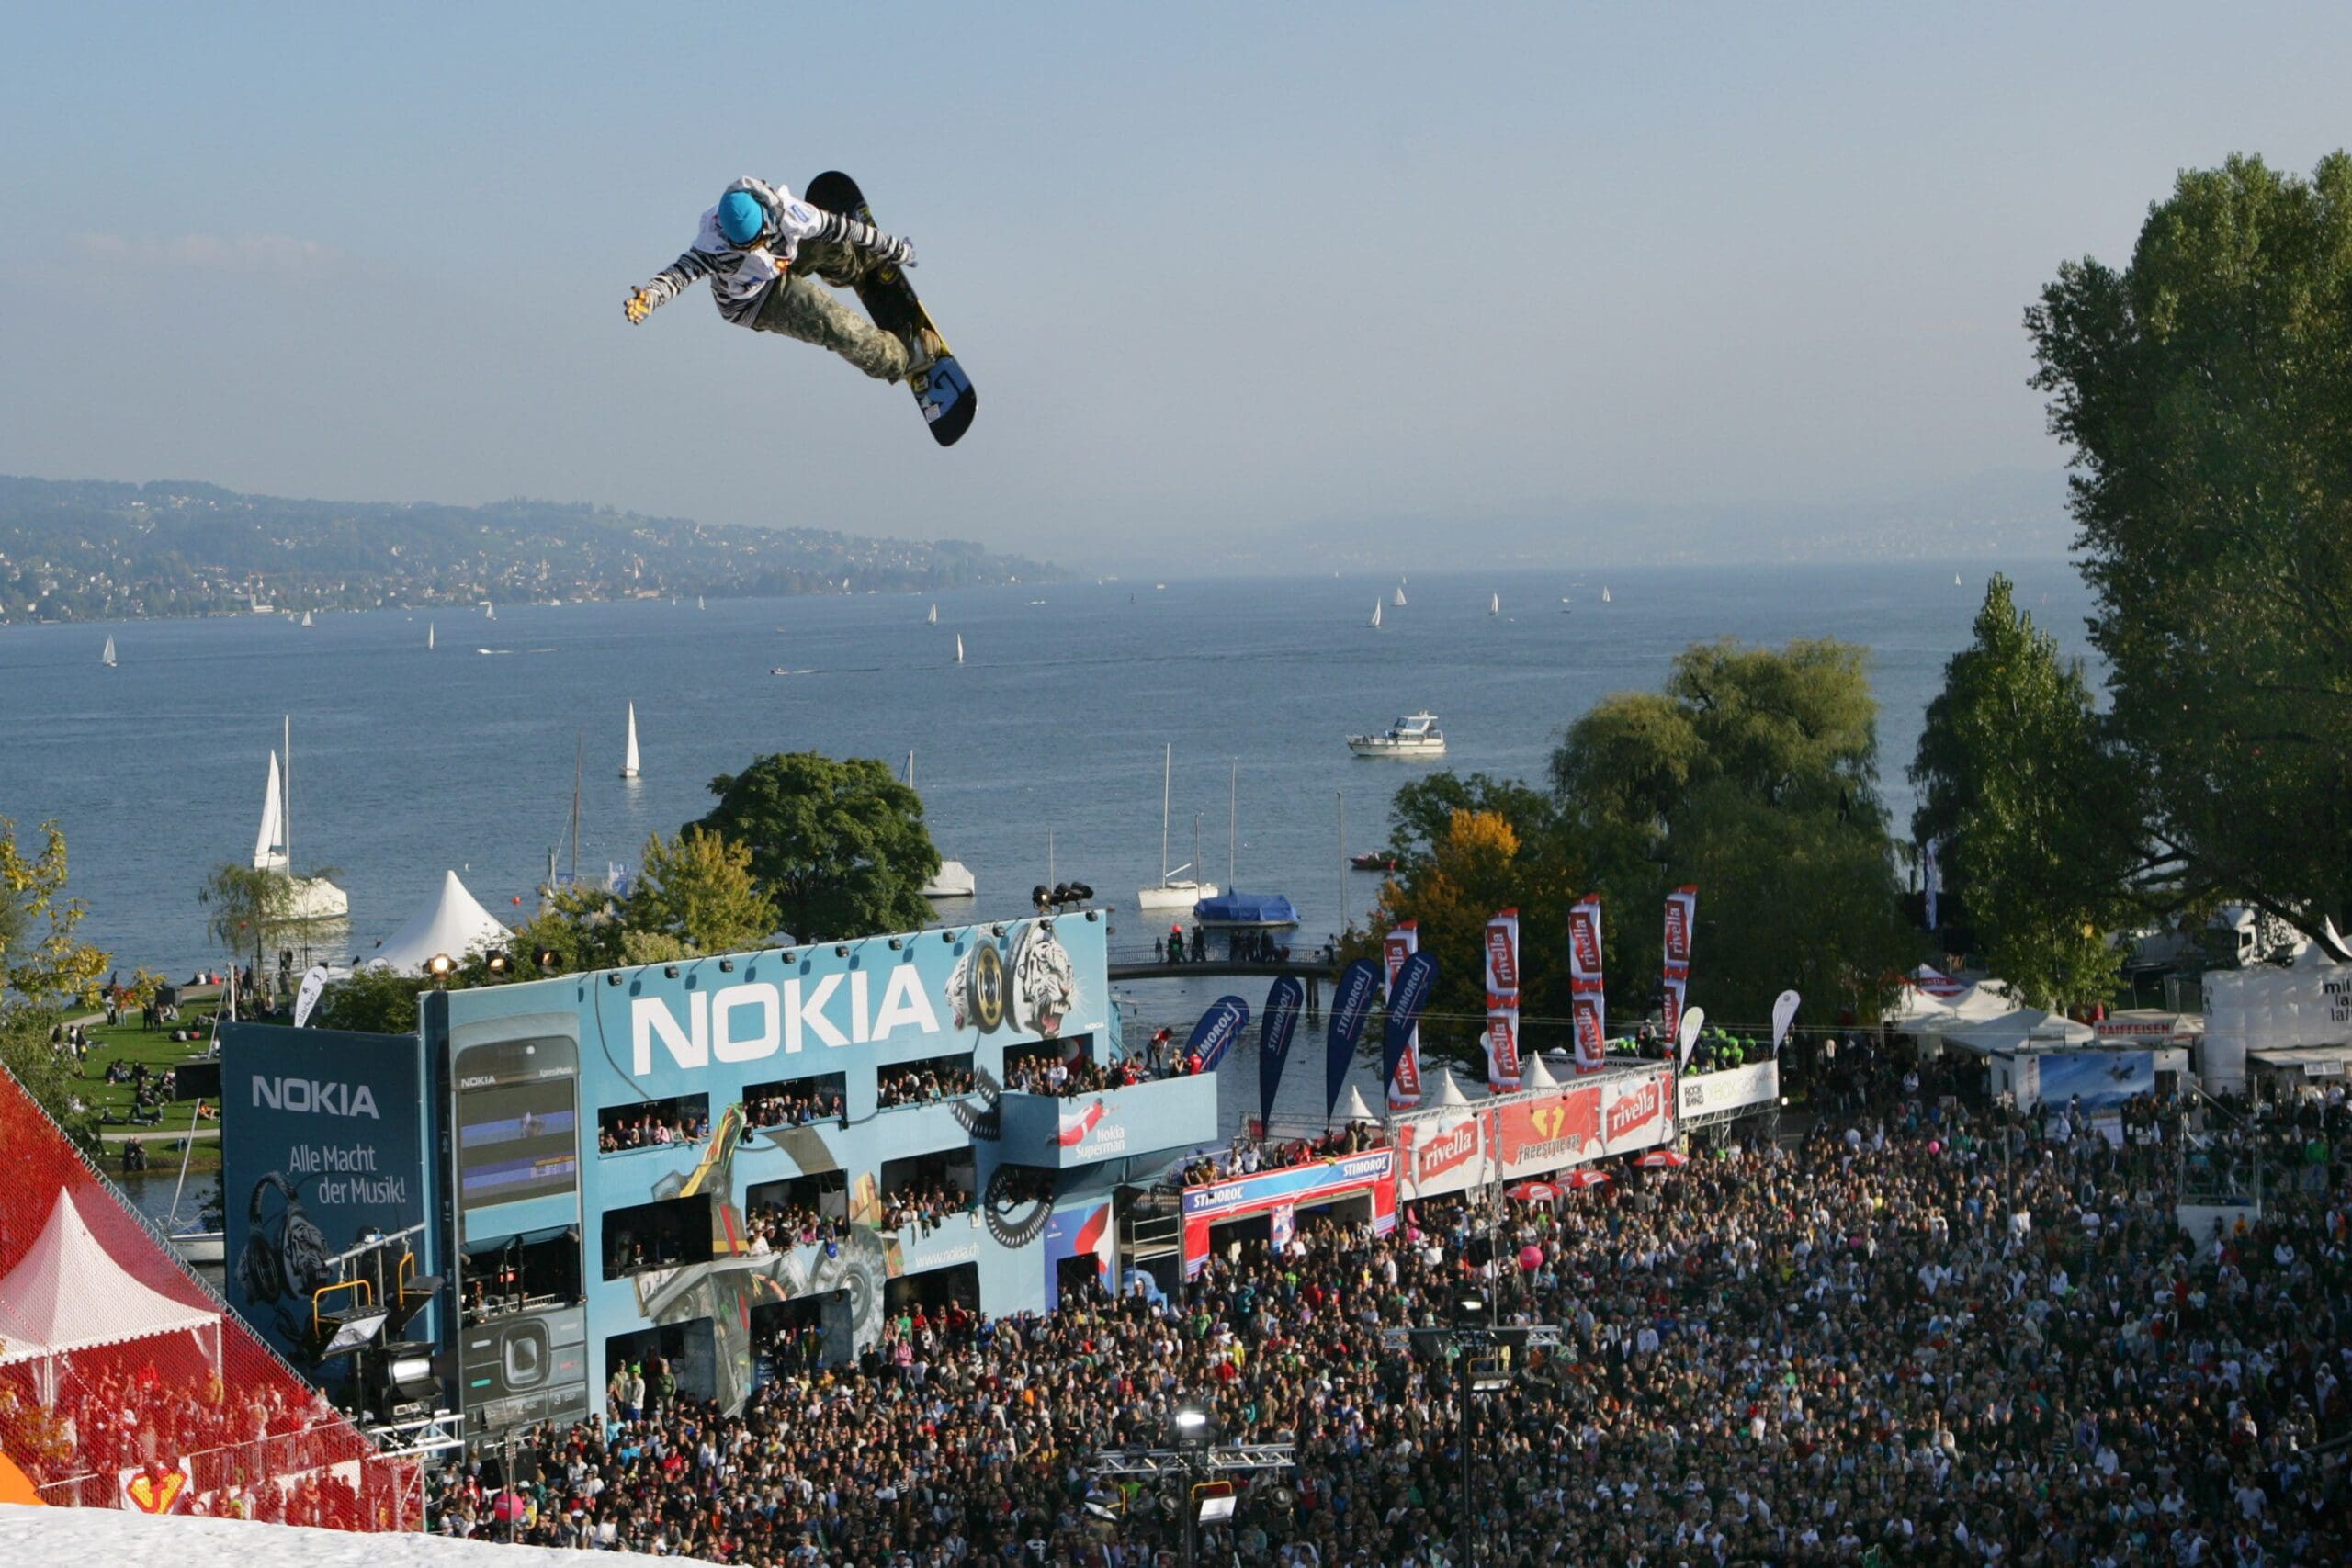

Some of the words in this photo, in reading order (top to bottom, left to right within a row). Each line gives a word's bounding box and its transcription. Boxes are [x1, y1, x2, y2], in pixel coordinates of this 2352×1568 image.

[1574, 919, 1596, 965] rivella
[1667, 908, 1683, 953] rivella
[1490, 933, 1512, 980] rivella
[1337, 974, 1367, 1035] STIMOROL
[1392, 962, 1424, 1024] STIMOROL
[631, 964, 940, 1077] NOKIA
[1197, 1012, 1233, 1058] IMOROL
[1268, 991, 1291, 1051] STIMOROL
[1578, 1007, 1600, 1053] rivella
[2098, 1023, 2170, 1035] RAIFFEISEN
[1492, 1023, 1514, 1070] rivella
[461, 1075, 496, 1088] NOKIA
[1397, 1051, 1414, 1088] rive
[252, 1075, 380, 1120] NOKIA
[1612, 1091, 1655, 1130] rivella
[1075, 1138, 1125, 1159] Superman
[1097, 1124, 1125, 1142] Nokia
[1425, 1132, 1471, 1170] rivella
[289, 1145, 321, 1173] Alle
[323, 1144, 377, 1172] Macht
[1342, 1156, 1387, 1177] STIMOROL
[318, 1177, 346, 1204] der
[350, 1176, 407, 1205] Musik!
[915, 1242, 979, 1268] www.nokia.ch
